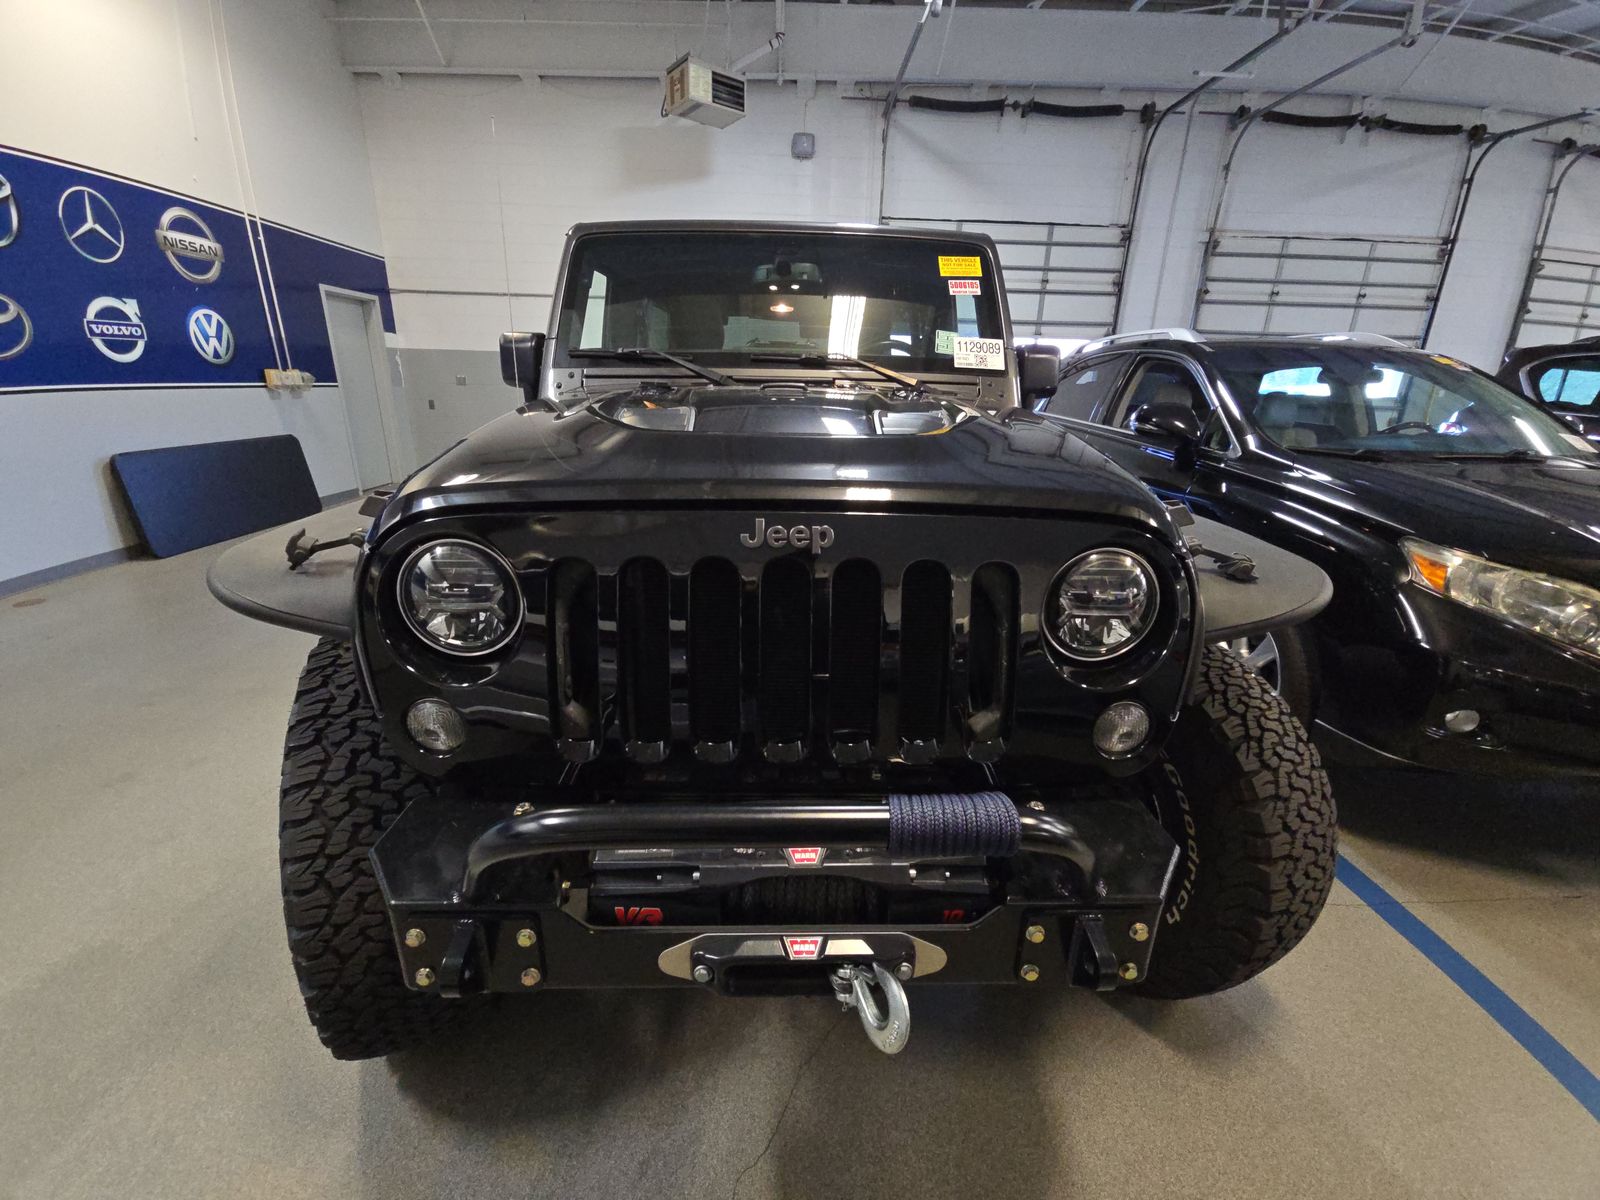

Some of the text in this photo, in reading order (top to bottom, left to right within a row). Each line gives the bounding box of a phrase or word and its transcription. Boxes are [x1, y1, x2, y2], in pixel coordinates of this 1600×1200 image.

[163, 235, 218, 257] NISSAN
[89, 324, 142, 336] VOLVO
[957, 341, 1001, 355] 1129089
[740, 517, 835, 555] Jeep
